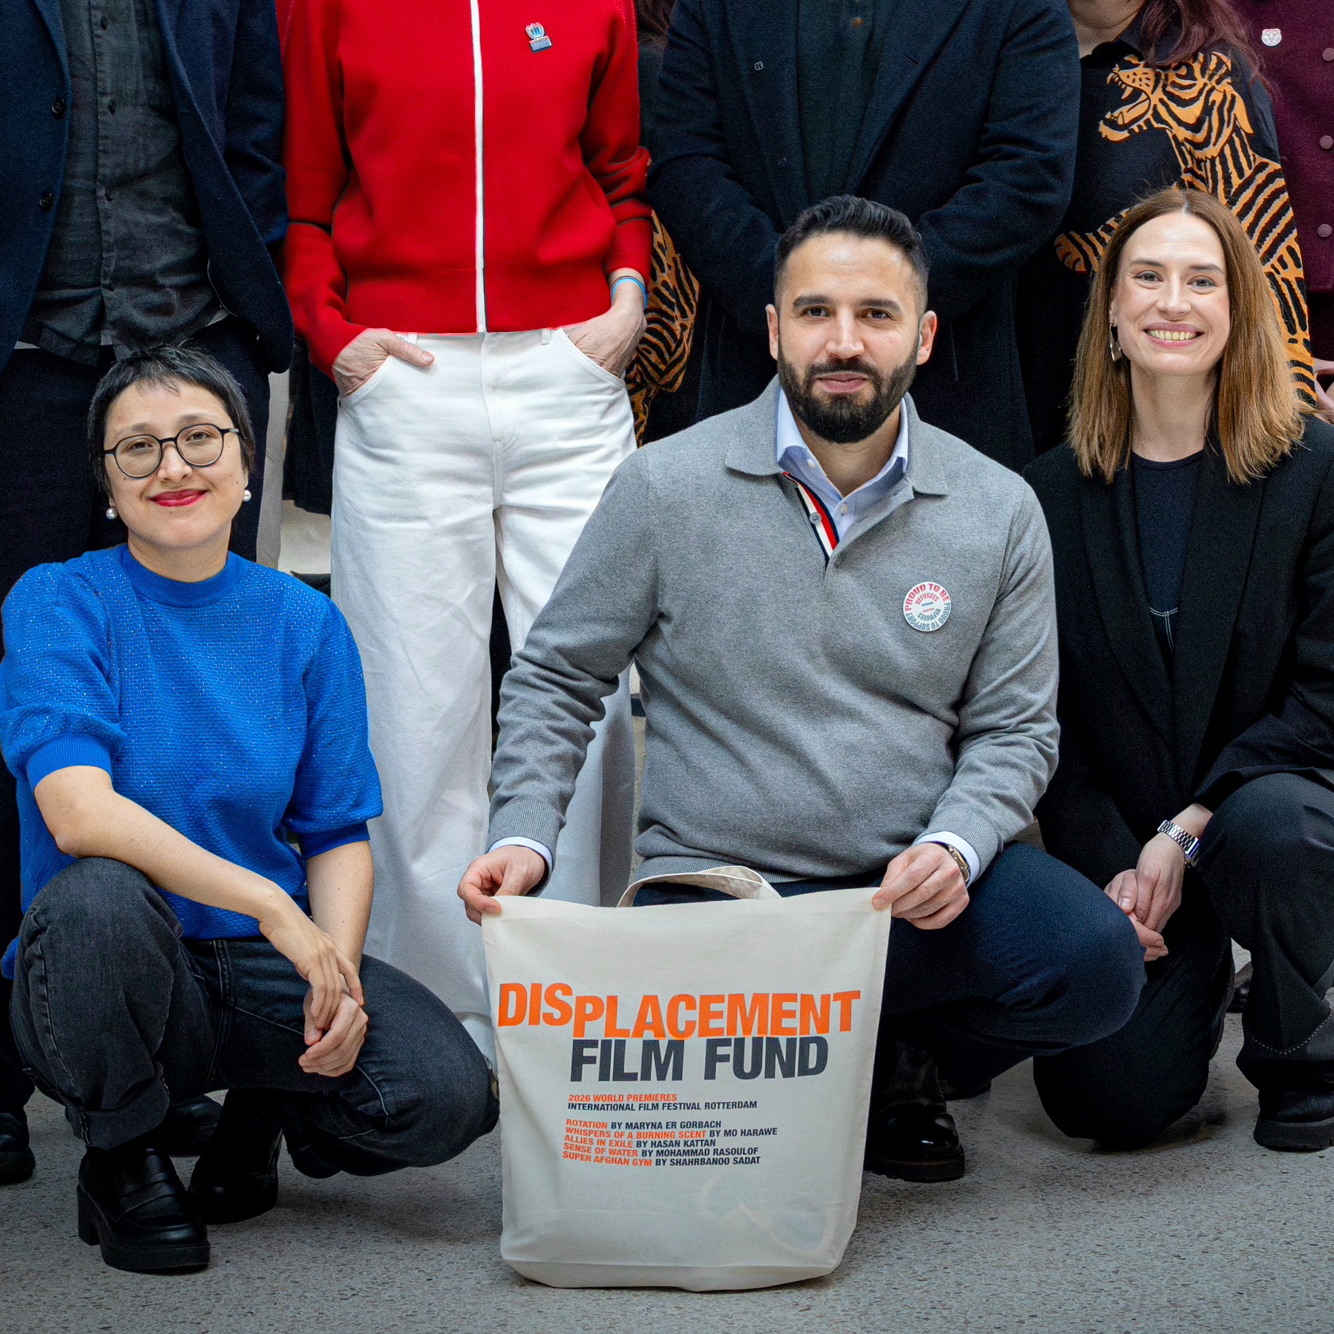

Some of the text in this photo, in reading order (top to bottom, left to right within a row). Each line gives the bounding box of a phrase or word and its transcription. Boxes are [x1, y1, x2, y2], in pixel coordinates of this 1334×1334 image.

[905, 583, 949, 611] PROUD TO BE
[498, 982, 861, 1040] DISPLACEMENT
[570, 1036, 829, 1082] FILM FUND
[568, 1094, 677, 1102] 2026 WORLD PREMIERES
[568, 1103, 635, 1111] INTERNATIONAL
[704, 1101, 757, 1110] ROTTERDAM
[566, 1119, 608, 1129] ROTATION
[611, 1122, 623, 1130] BY
[625, 1122, 663, 1130] MARYNA
[680, 1121, 721, 1129] GORBACH
[566, 1127, 611, 1138] WHISPERS
[614, 1130, 625, 1139] OF
[678, 1131, 706, 1139] SCENT
[709, 1130, 721, 1138] BY
[724, 1129, 738, 1137] MO
[740, 1128, 777, 1137] HARAWE
[564, 1135, 594, 1146] ALLIES
[597, 1139, 606, 1147] IN
[609, 1140, 633, 1148] EXILE
[651, 1140, 681, 1148] HASAN
[683, 1139, 716, 1147] KATTAN
[564, 1143, 592, 1154] SENSE
[595, 1147, 606, 1155] OF
[609, 1148, 638, 1157] WATER
[656, 1149, 710, 1157] MOHAMMAD
[713, 1147, 759, 1156] RASOULOF
[563, 1151, 591, 1162] SUPER
[594, 1156, 629, 1165] AFGHAN
[669, 1158, 730, 1166] SHAHRBANOO
[733, 1156, 761, 1165] SADAT
